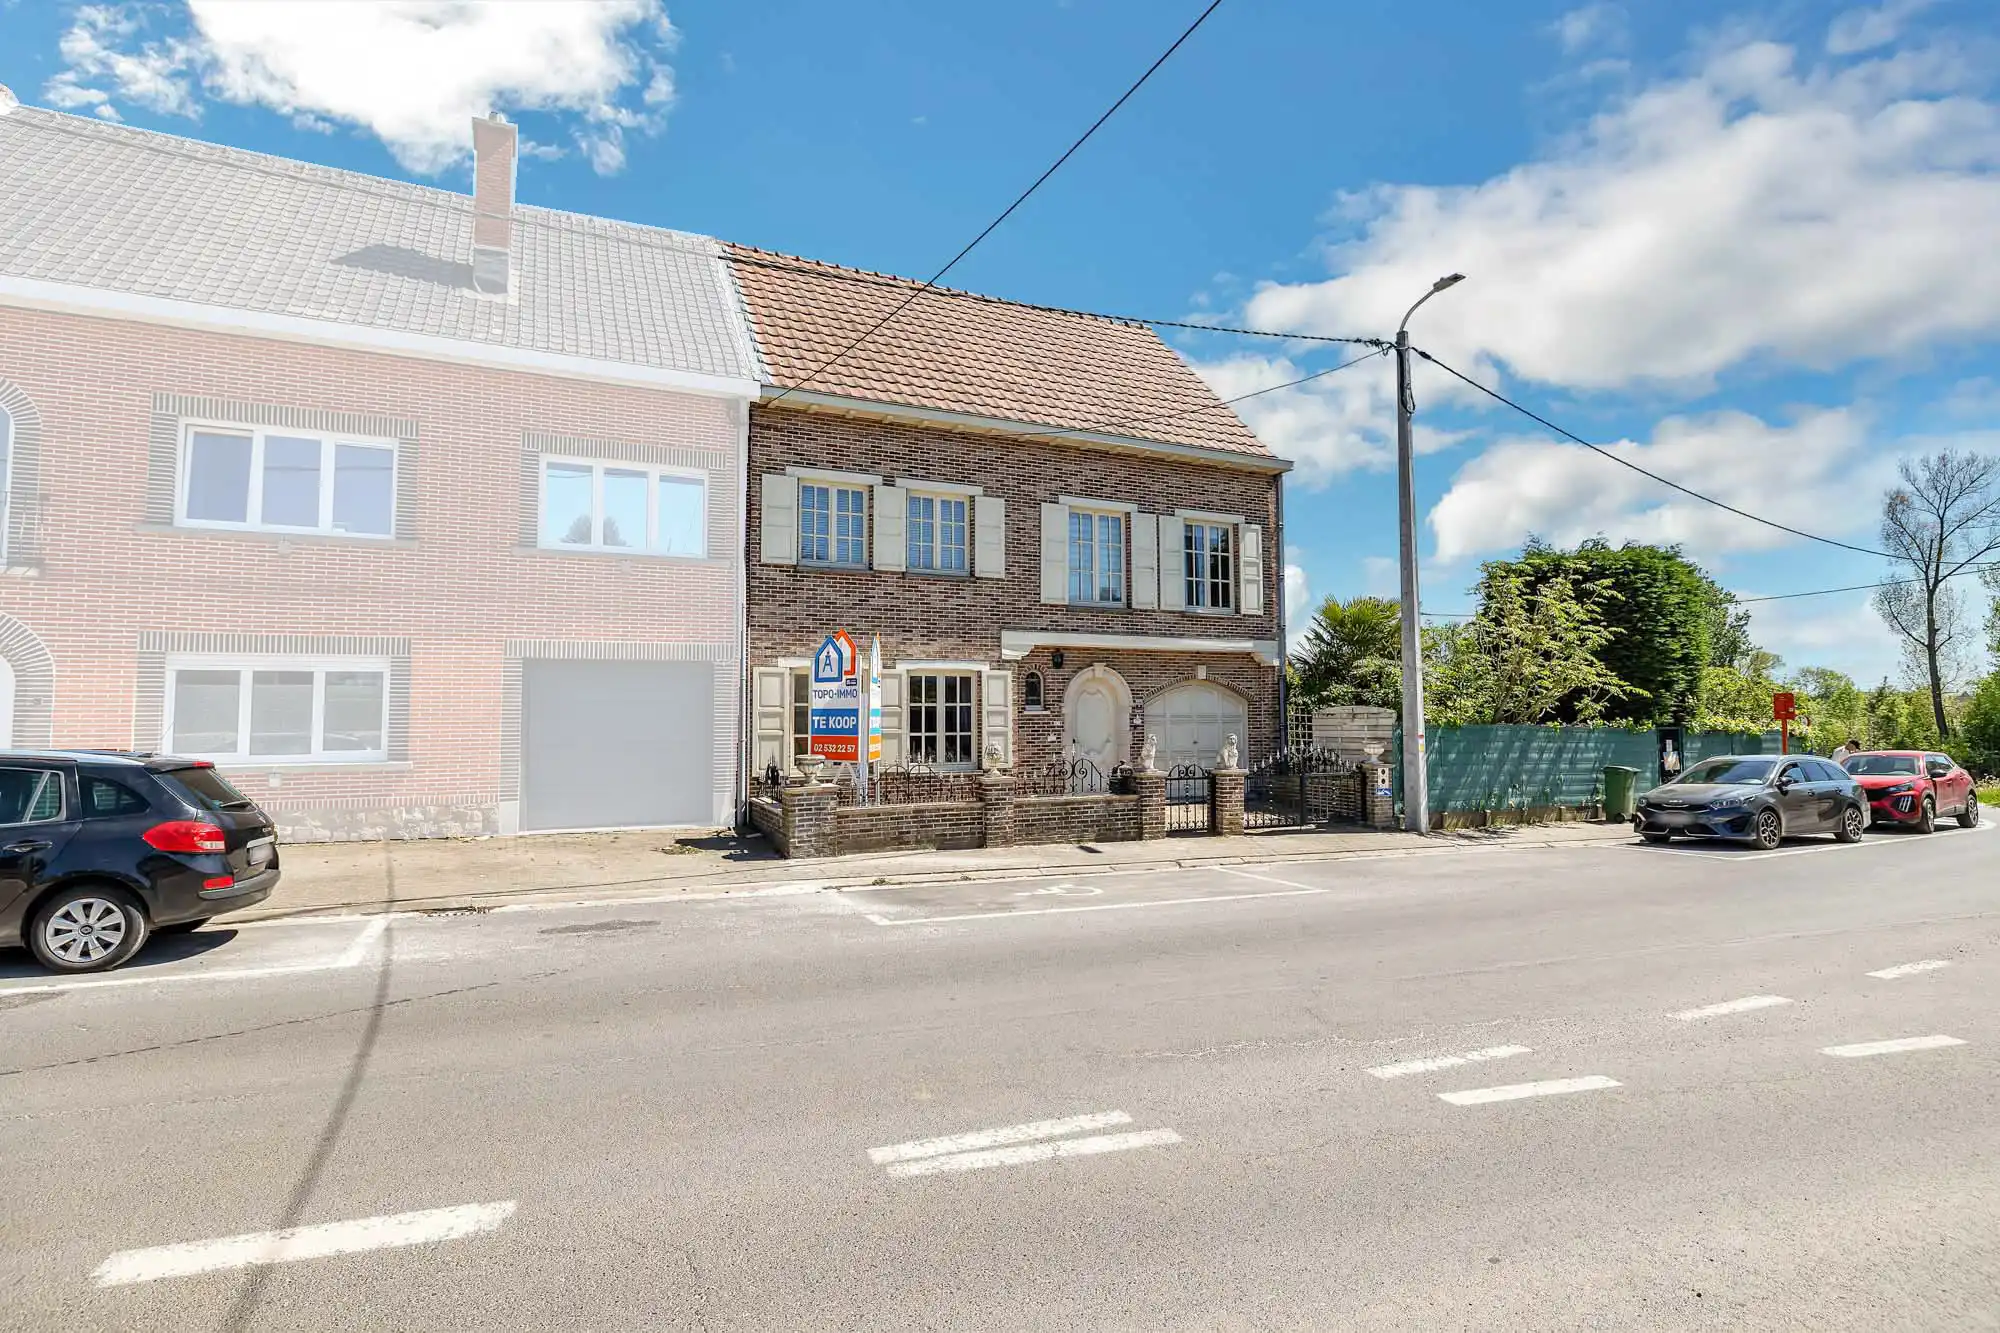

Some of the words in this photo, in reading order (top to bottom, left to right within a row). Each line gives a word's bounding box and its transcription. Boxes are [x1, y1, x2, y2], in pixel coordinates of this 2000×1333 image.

[812, 716, 827, 728] TE
[828, 716, 857, 728] KOOP
[814, 744, 823, 752] 02
[823, 744, 837, 752] 532
[837, 744, 846, 752] 22
[847, 744, 856, 752] 57
